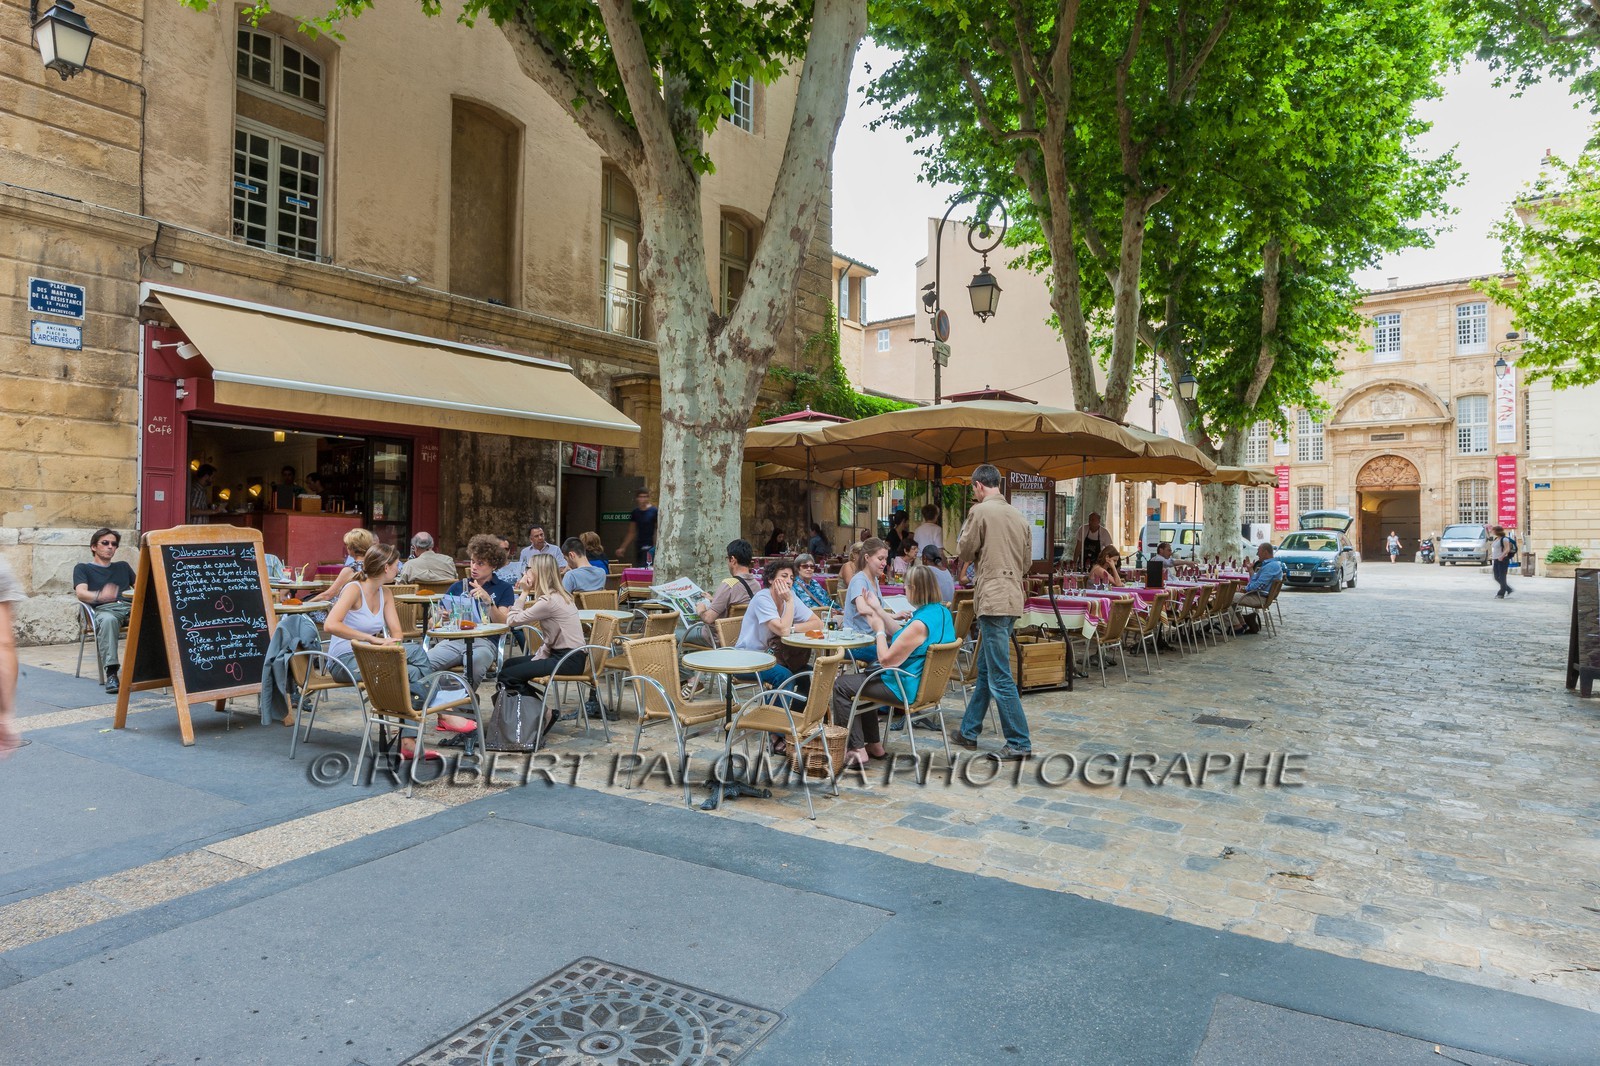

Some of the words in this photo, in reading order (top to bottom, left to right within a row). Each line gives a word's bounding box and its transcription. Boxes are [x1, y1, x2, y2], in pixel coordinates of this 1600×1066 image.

[51, 290, 77, 299] MARTYRS
[50, 296, 82, 306] RESISTANCE
[33, 333, 80, 345] L'ARCHEVESCAT
[147, 423, 172, 436] Café
[1010, 471, 1047, 483] RESTAURANT
[1019, 482, 1044, 490] PIZZERIA
[169, 546, 229, 559] SUGGESTION
[202, 561, 213, 569] de
[214, 560, 240, 569] canard
[211, 576, 222, 584] de
[174, 588, 182, 596] et
[180, 610, 248, 630] SUGGESTION
[215, 632, 227, 642] du
[228, 650, 237, 659] et
